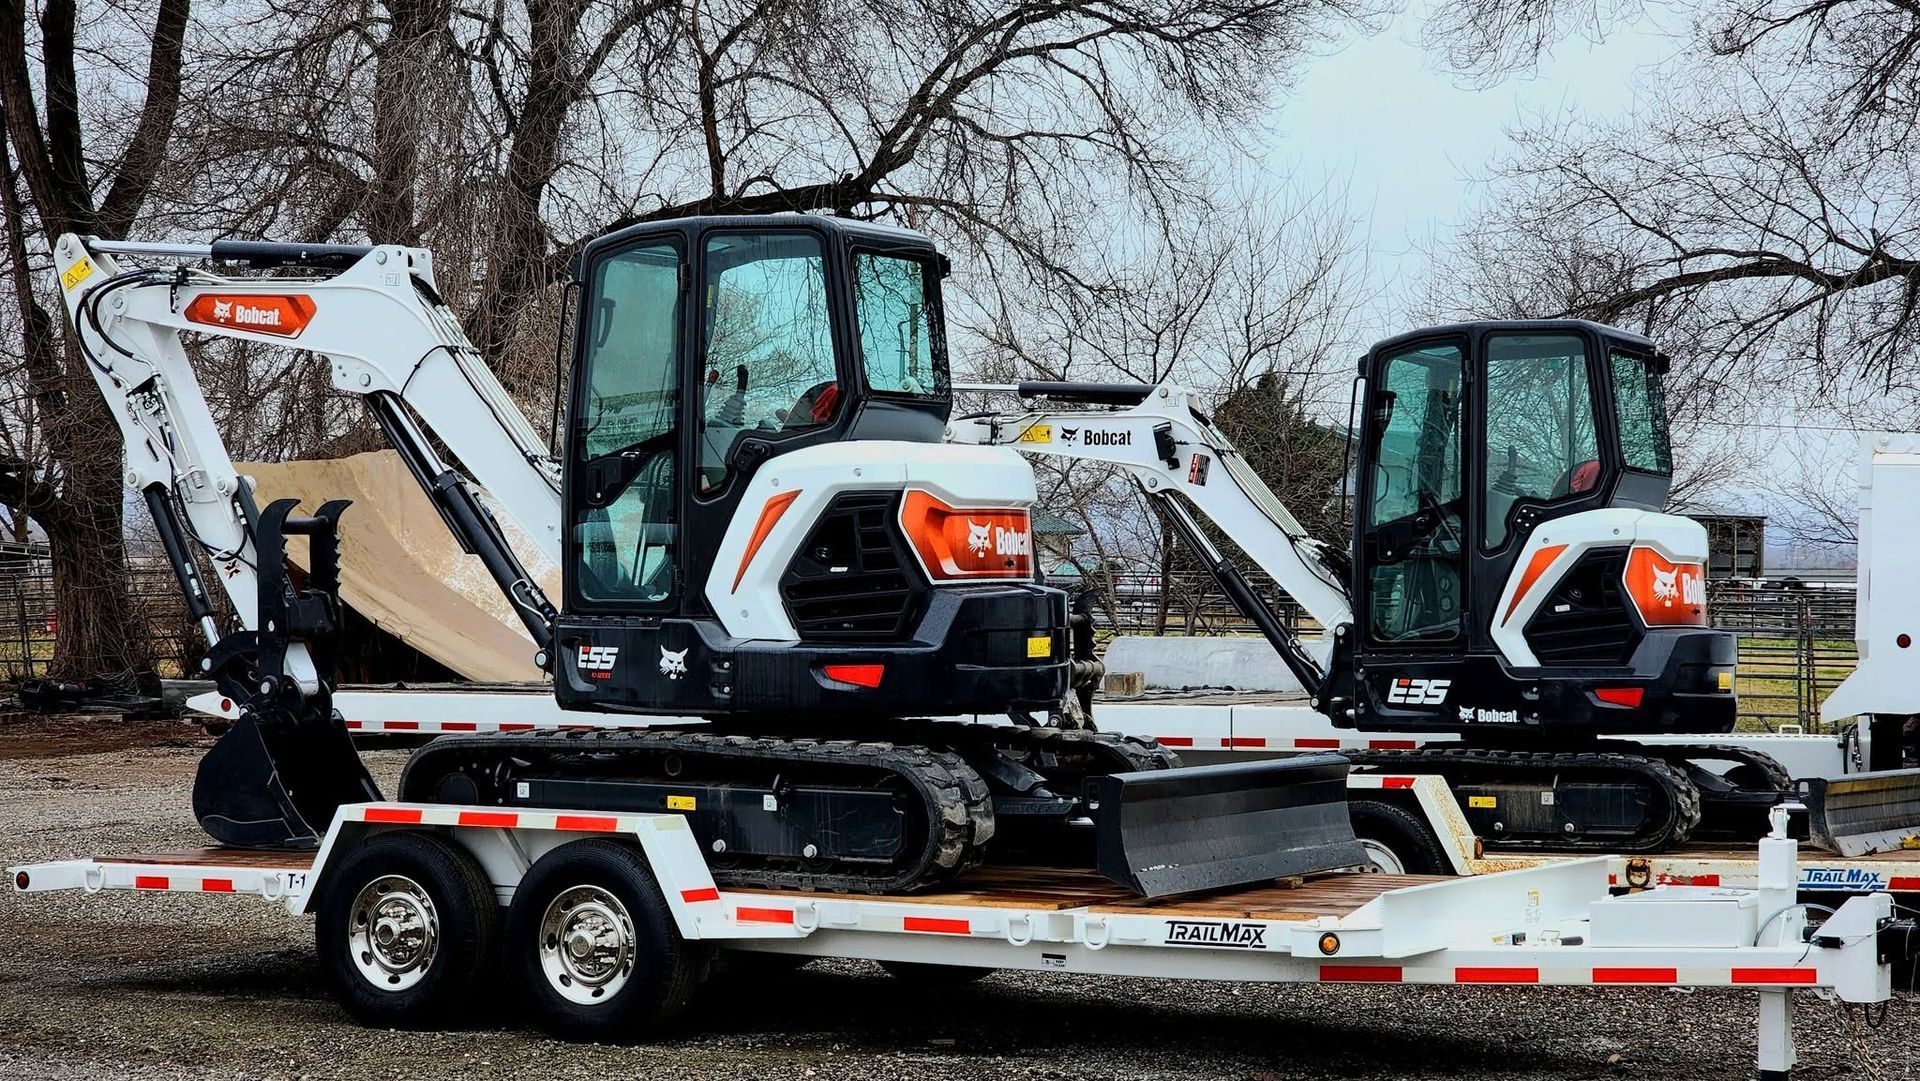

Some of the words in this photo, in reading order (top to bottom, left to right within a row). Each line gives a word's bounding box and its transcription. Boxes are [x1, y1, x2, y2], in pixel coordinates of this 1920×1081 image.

[235, 305, 281, 326] Bobcat
[1084, 429, 1132, 446] Bobcat
[1681, 572, 1706, 606] Bob
[577, 645, 619, 670] E55
[1387, 678, 1452, 705] E35
[1477, 708, 1518, 723] Bobcat
